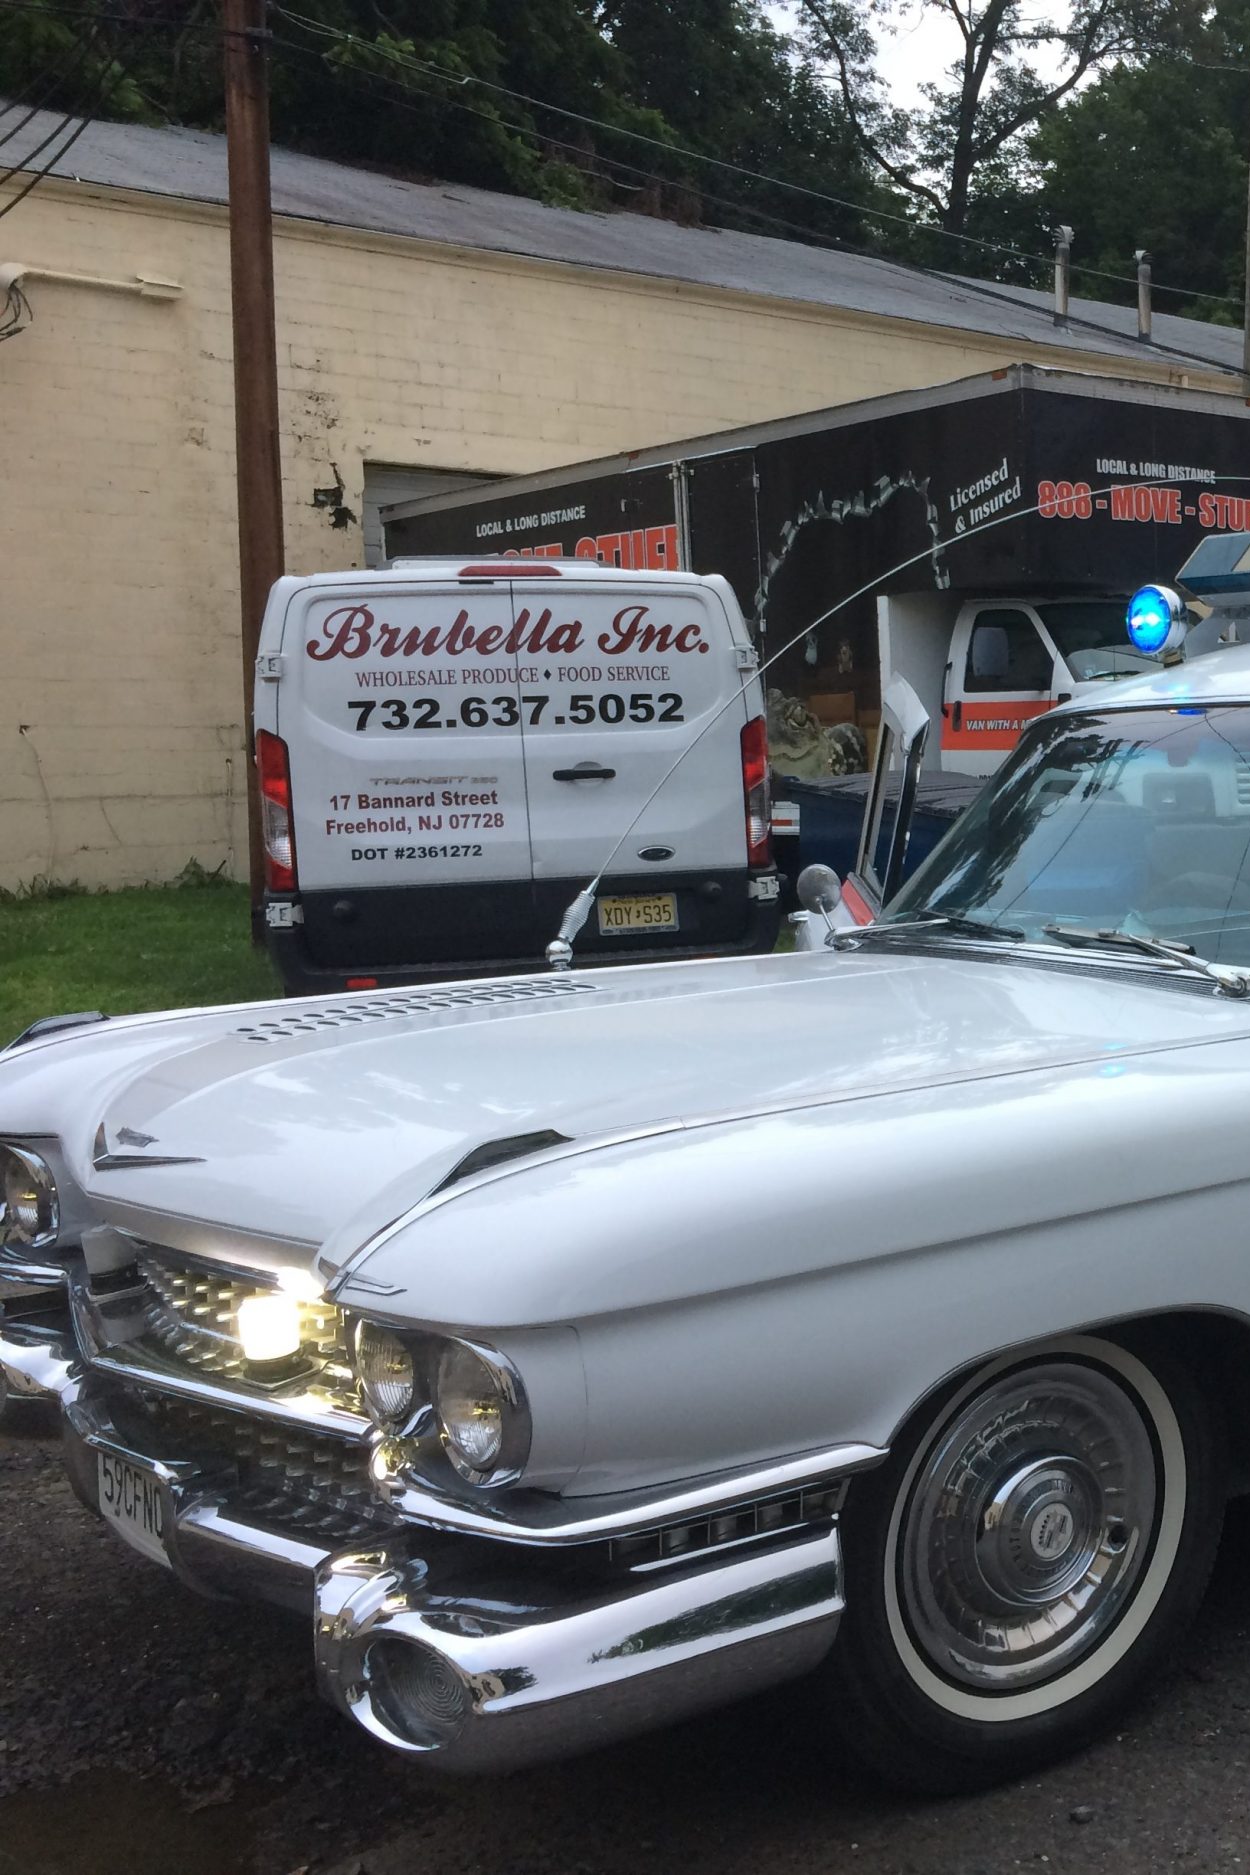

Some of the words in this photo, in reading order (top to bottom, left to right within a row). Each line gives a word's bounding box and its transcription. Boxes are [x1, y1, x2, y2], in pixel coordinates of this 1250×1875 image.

[1096, 458, 1128, 475] LOCAL
[1129, 462, 1138, 475] &
[1139, 461, 1166, 479] LONG
[1167, 464, 1216, 485] DISTANCE
[949, 457, 1009, 513] Licensed
[954, 517, 966, 534] &
[970, 476, 1022, 527] Insured
[1038, 480, 1092, 519] 888
[1110, 485, 1182, 524] MOVE
[476, 521, 504, 537] LOCAL
[506, 519, 513, 532] &
[514, 513, 539, 531] LONG
[540, 505, 586, 525] DISTANCE
[306, 604, 584, 661] Brubella
[597, 606, 709, 655] Inc.
[355, 669, 457, 688] WHOLESALE
[462, 667, 539, 685] PRODUCE
[558, 666, 602, 682] FOOD
[607, 666, 670, 682] SERVICE
[348, 693, 685, 731] 732.637.5052
[966, 720, 985, 731] VAN
[986, 719, 1010, 731] WITH
[1012, 720, 1019, 730] A
[368, 775, 468, 786] TRANSIT
[329, 795, 351, 811] 17
[357, 792, 435, 810] Bannard
[441, 790, 498, 806] Street
[325, 817, 412, 835] Freehold,
[418, 815, 442, 831] NJ
[448, 813, 505, 830] 07728
[351, 848, 388, 861] DOT
[395, 845, 483, 860] #2361272
[604, 906, 632, 926] XDY
